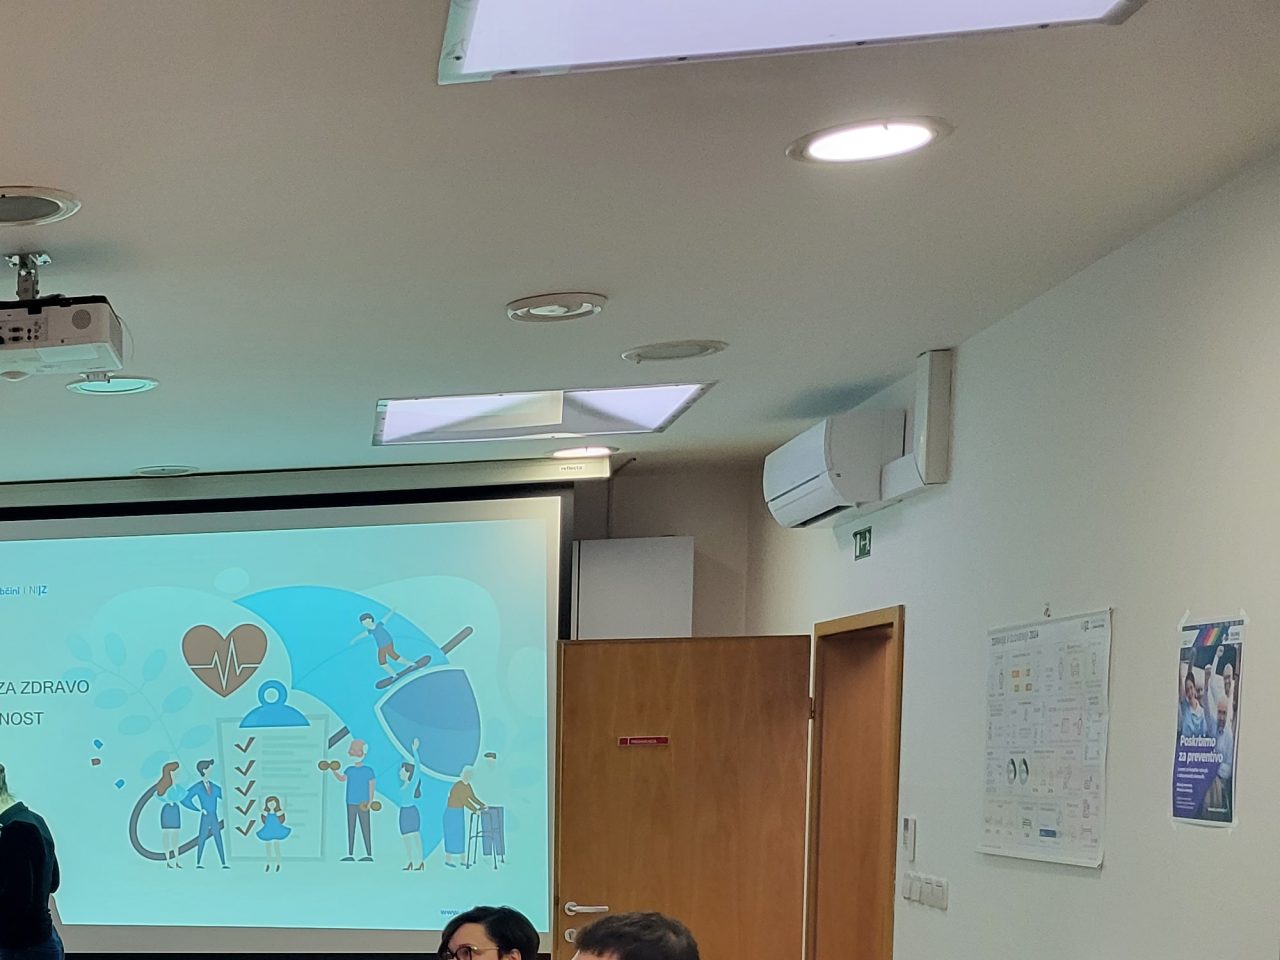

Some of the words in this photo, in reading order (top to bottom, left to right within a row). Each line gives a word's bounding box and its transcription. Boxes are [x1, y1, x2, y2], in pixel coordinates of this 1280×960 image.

[20, 680, 90, 695] ZDRAVO
[1180, 734, 1216, 747] Poskrbimo
[1179, 752, 1187, 762] za
[1187, 749, 1224, 764] preventivo
